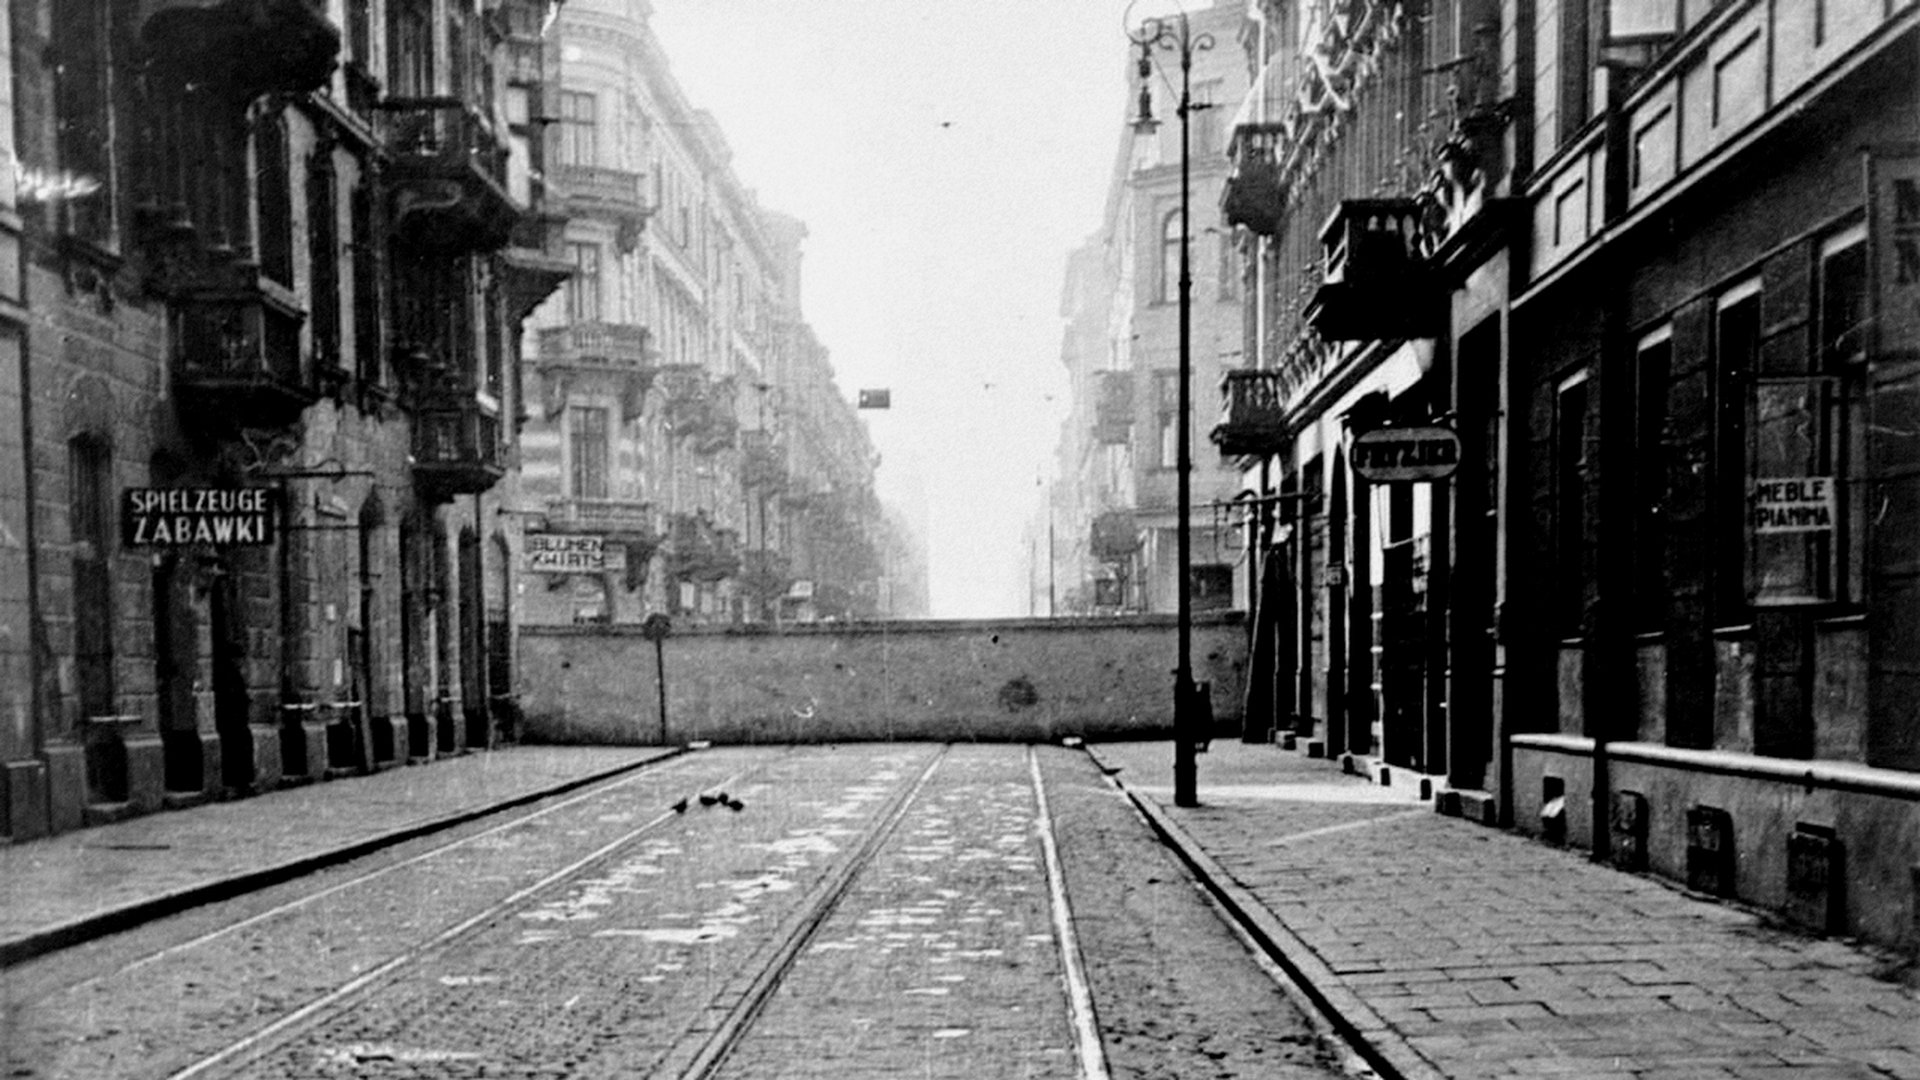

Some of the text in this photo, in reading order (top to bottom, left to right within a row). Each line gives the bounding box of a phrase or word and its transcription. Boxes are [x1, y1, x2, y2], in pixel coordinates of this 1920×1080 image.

[131, 489, 267, 512] SPIELZEUGE
[1757, 481, 1825, 502] MEBLE
[133, 516, 264, 543] ZABAWKI
[532, 537, 605, 551] BLUMEN
